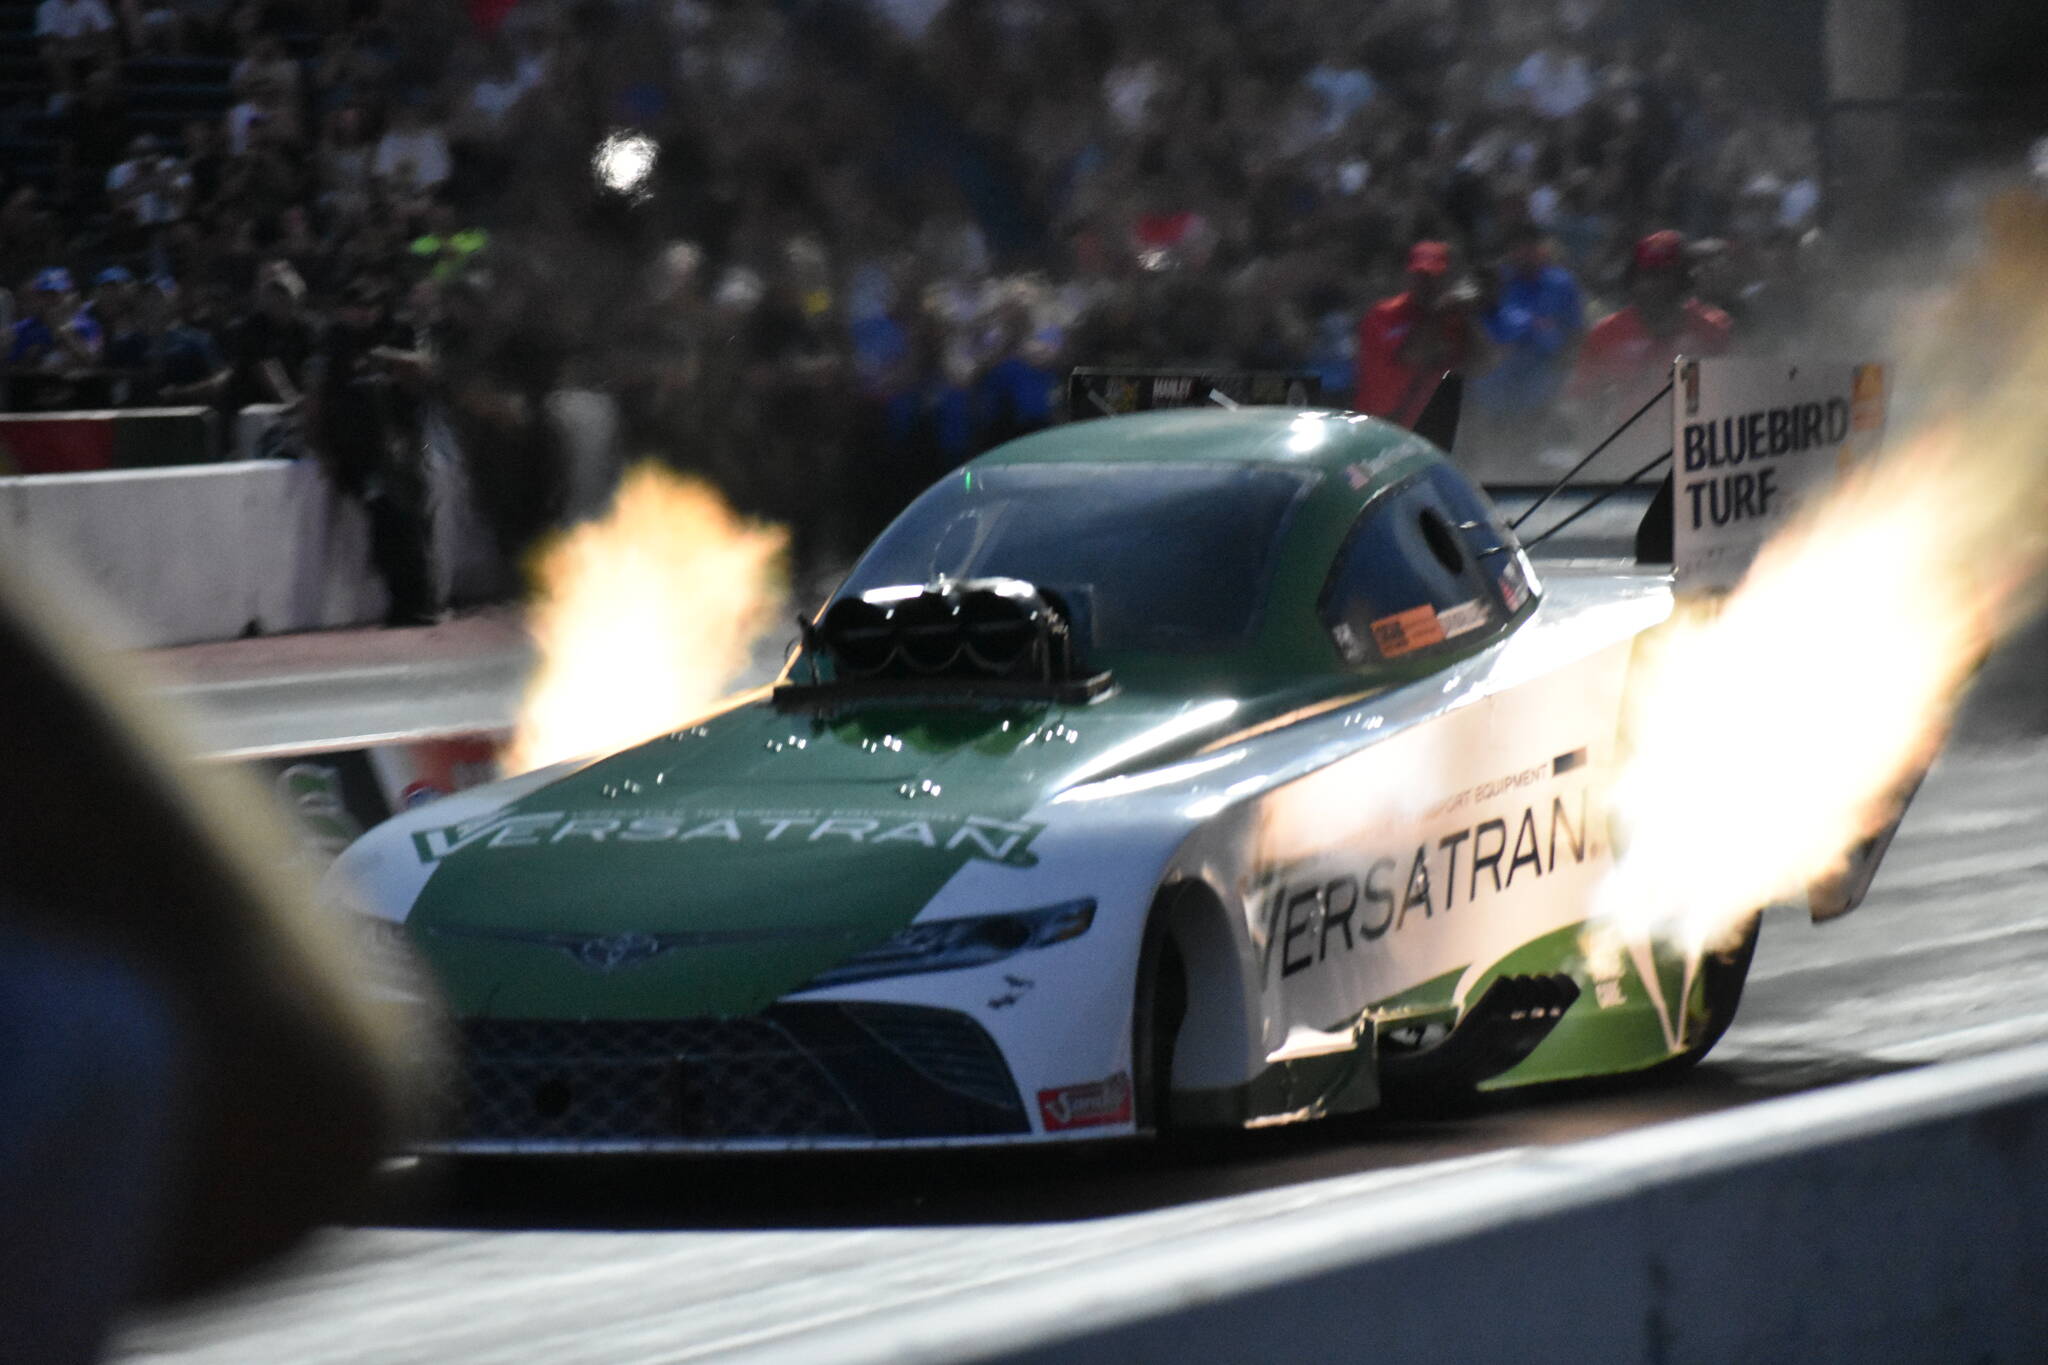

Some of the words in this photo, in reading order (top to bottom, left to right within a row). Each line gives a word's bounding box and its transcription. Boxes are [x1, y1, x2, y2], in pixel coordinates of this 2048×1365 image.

[1684, 396, 1848, 473] BLUEBIRD
[1686, 466, 1779, 530] TURF
[1474, 763, 1548, 803] EQUIPMENT
[416, 806, 1034, 862] VERSATRAN
